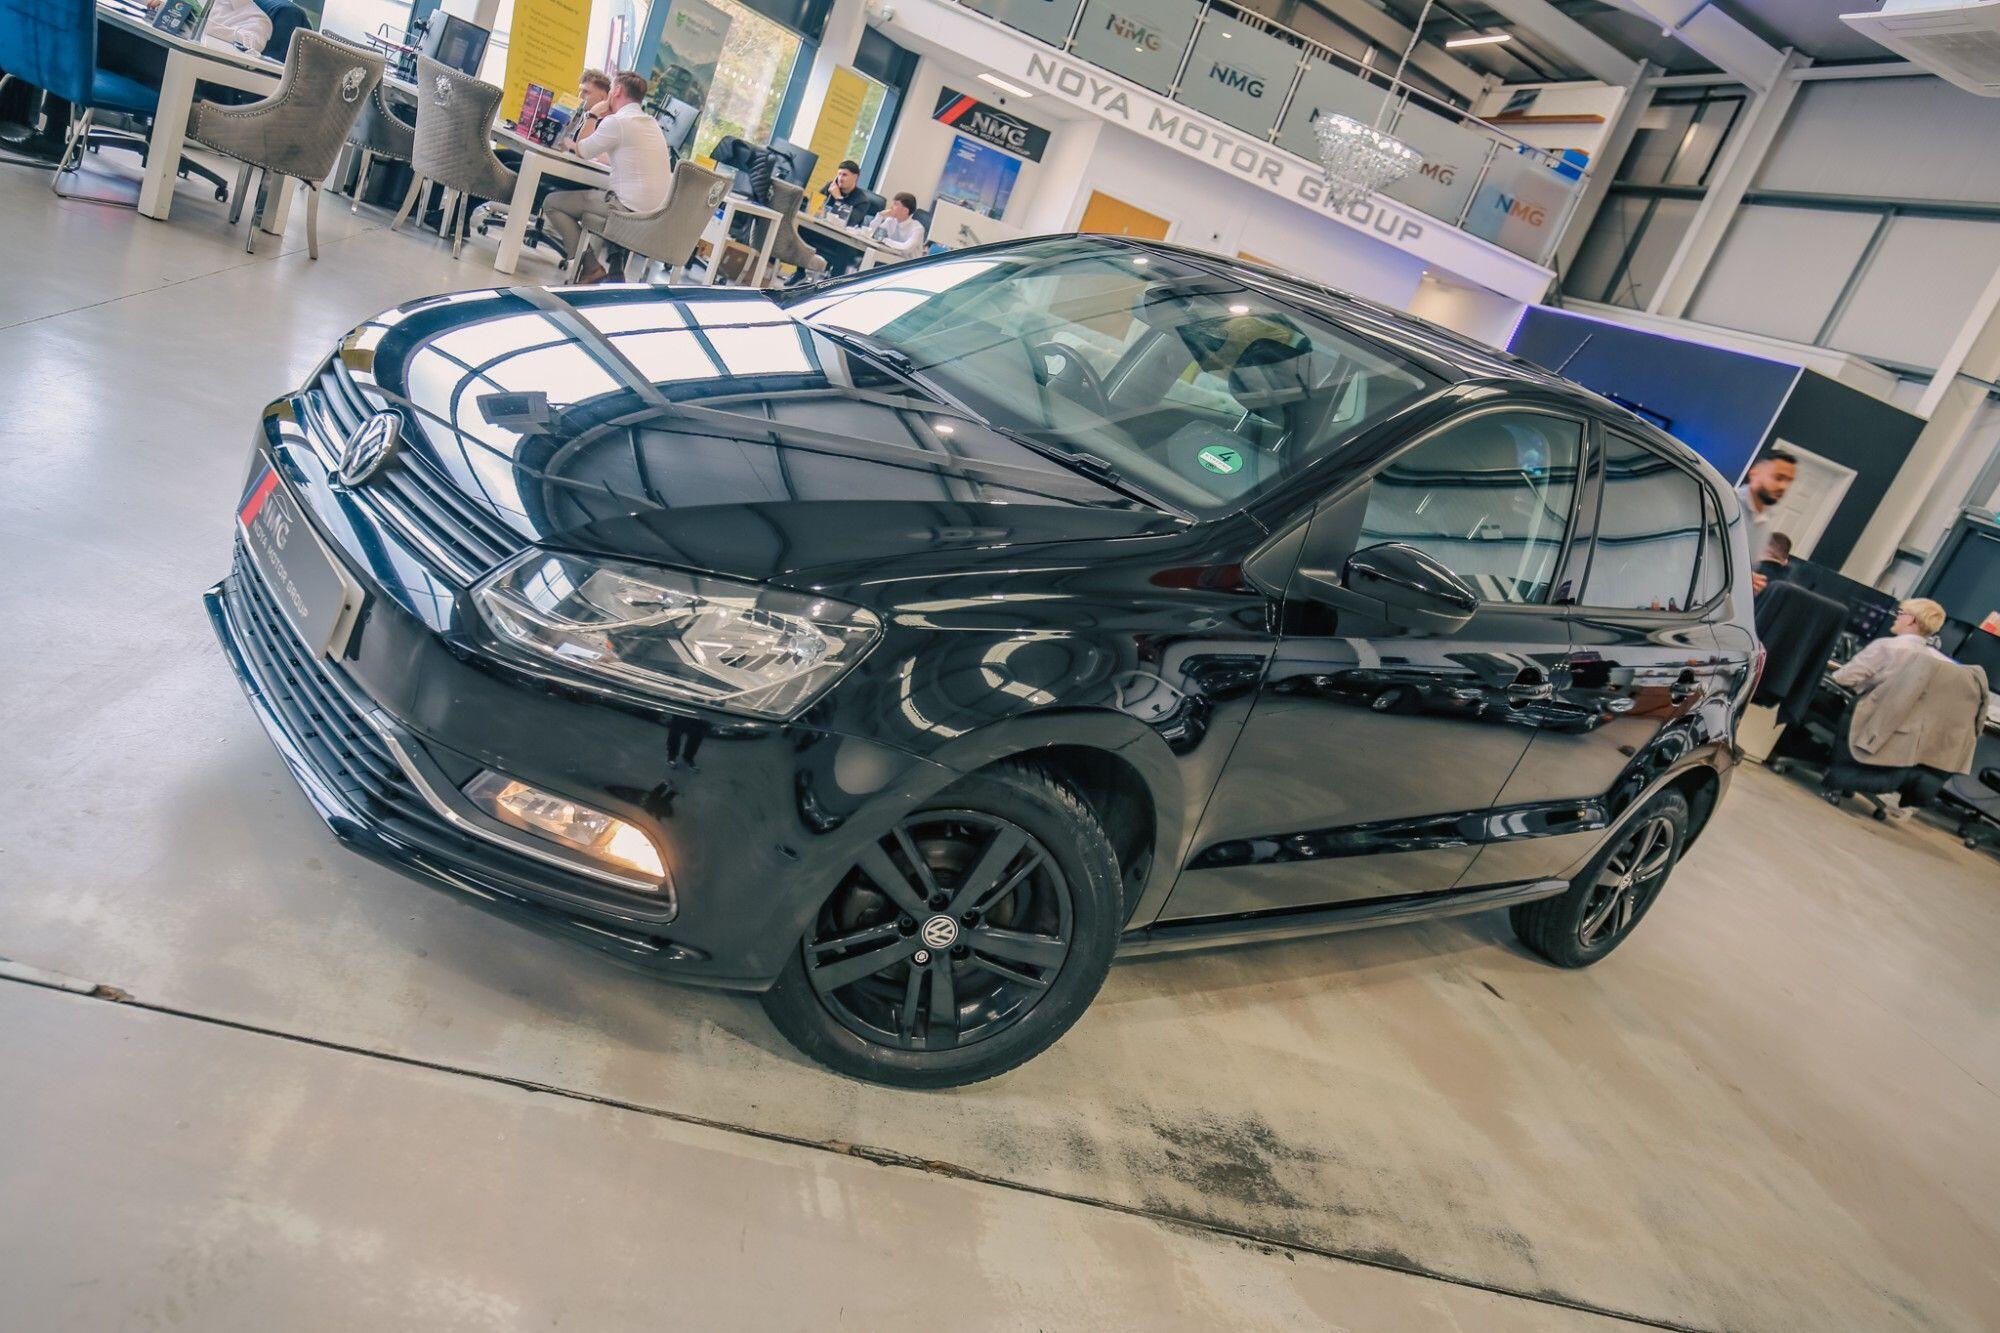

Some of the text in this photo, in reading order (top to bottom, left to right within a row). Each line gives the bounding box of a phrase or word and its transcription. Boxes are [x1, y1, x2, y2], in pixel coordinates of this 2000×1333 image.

[1106, 13, 1162, 51] NMG
[1209, 61, 1265, 99] NMG
[959, 123, 978, 136] NOYA
[980, 132, 1005, 146] MOTOR
[971, 111, 1027, 147] NMG
[1026, 53, 1130, 120] NOYA
[1148, 107, 1284, 186] MOTOR
[1419, 163, 1455, 187] MG
[1495, 193, 1545, 227] NMG
[1218, 451, 1235, 463] 4
[267, 545, 288, 584] MOTOR
[286, 580, 309, 617] GROUP
